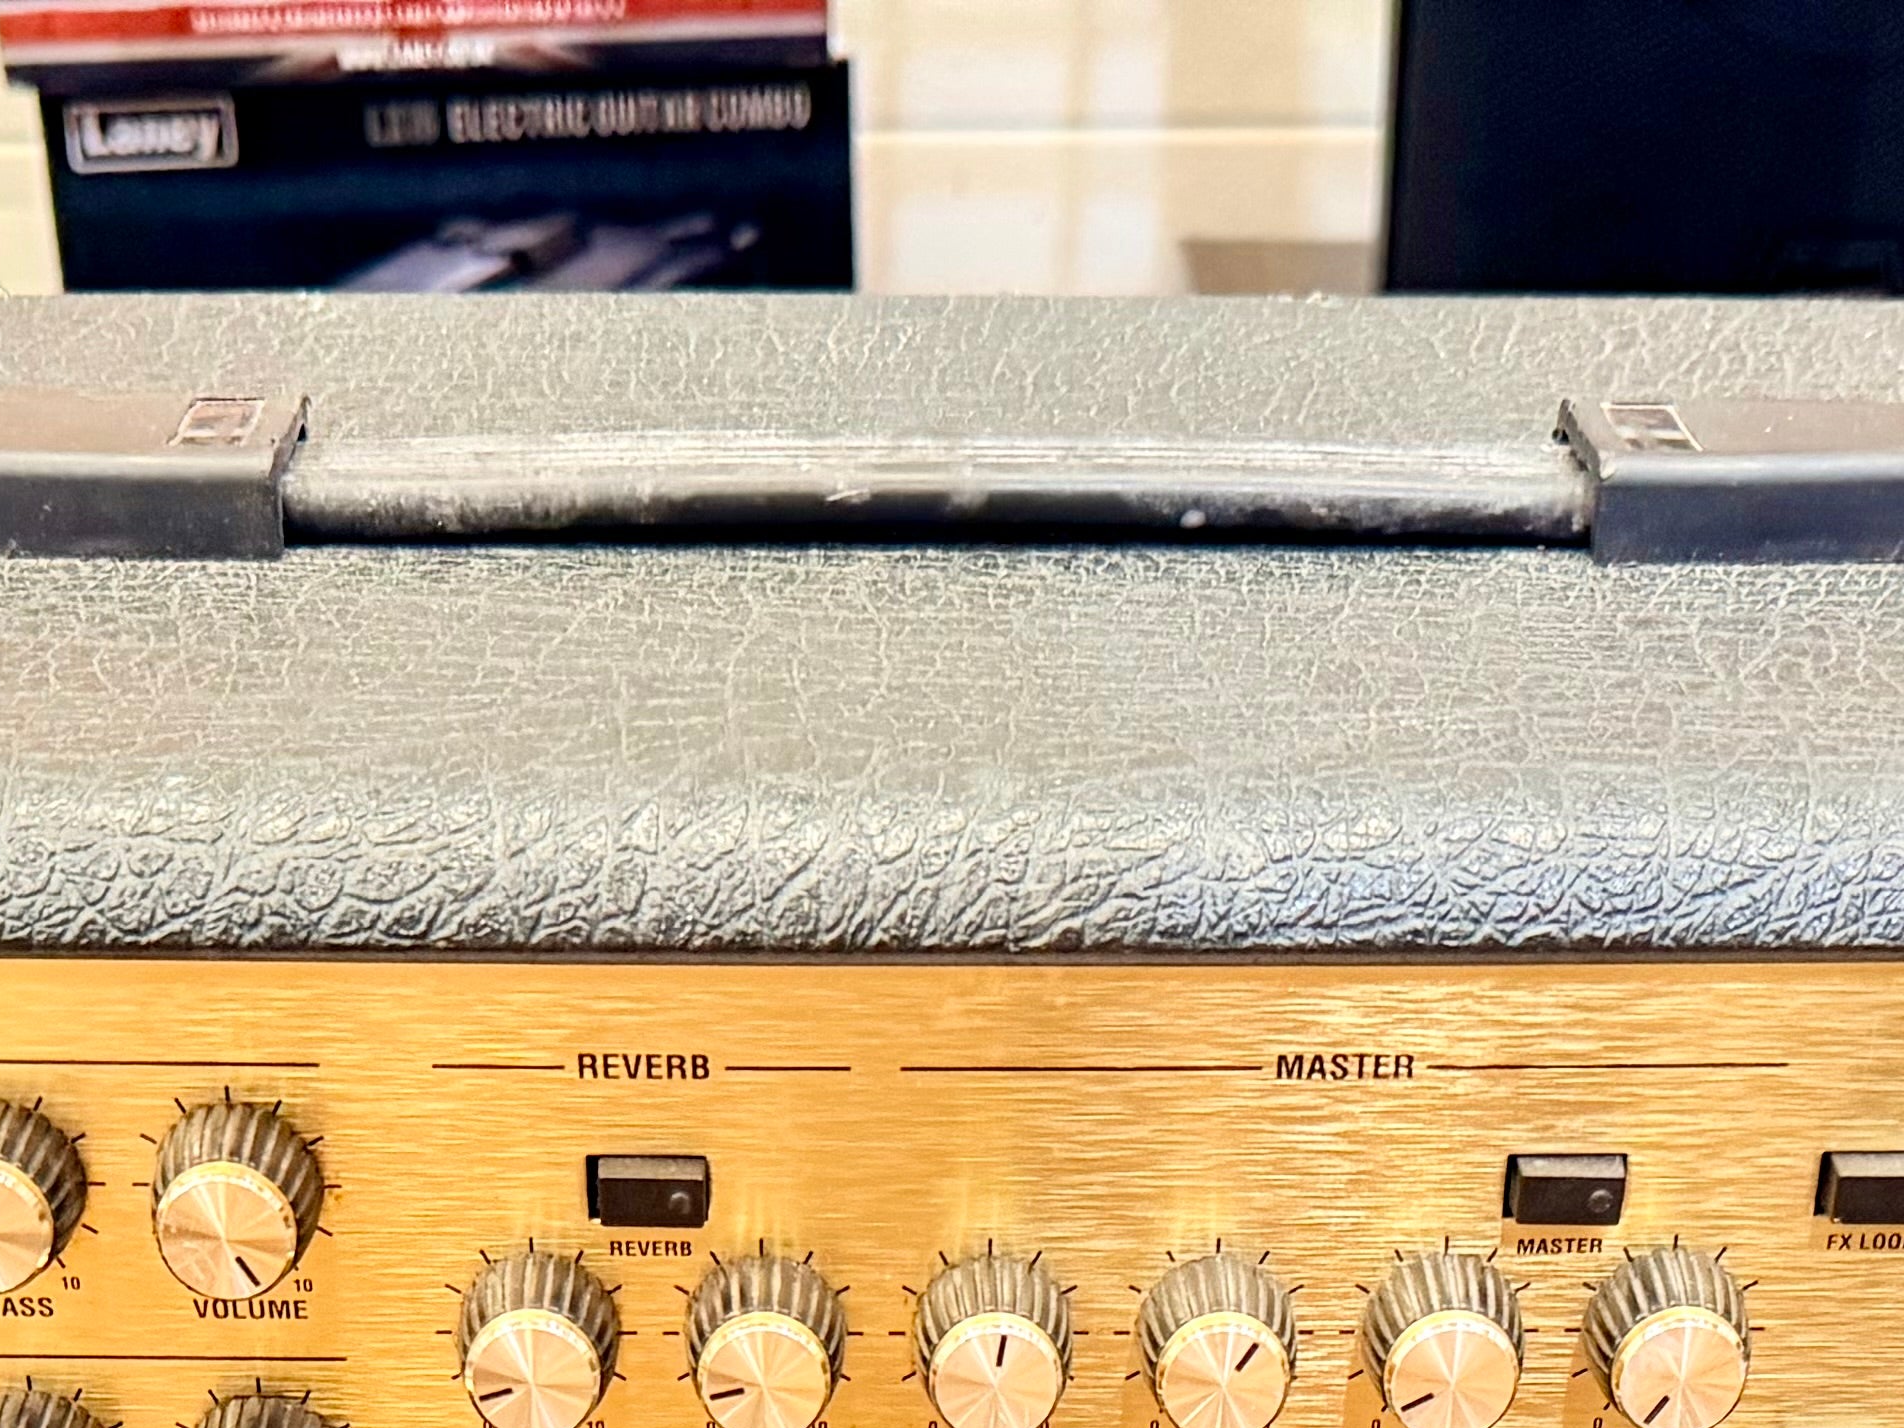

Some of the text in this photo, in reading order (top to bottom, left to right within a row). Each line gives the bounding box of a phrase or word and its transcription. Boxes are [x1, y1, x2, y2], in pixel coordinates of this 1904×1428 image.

[577, 1053, 710, 1080] REVERB
[1275, 1052, 1415, 1081] MASTER
[609, 1240, 692, 1257] REVERB
[1517, 1236, 1603, 1255] MASTER
[1826, 1232, 1854, 1251] FX
[62, 1276, 81, 1290] 10
[294, 1278, 313, 1292] 10
[194, 1299, 308, 1320] VOLUME
